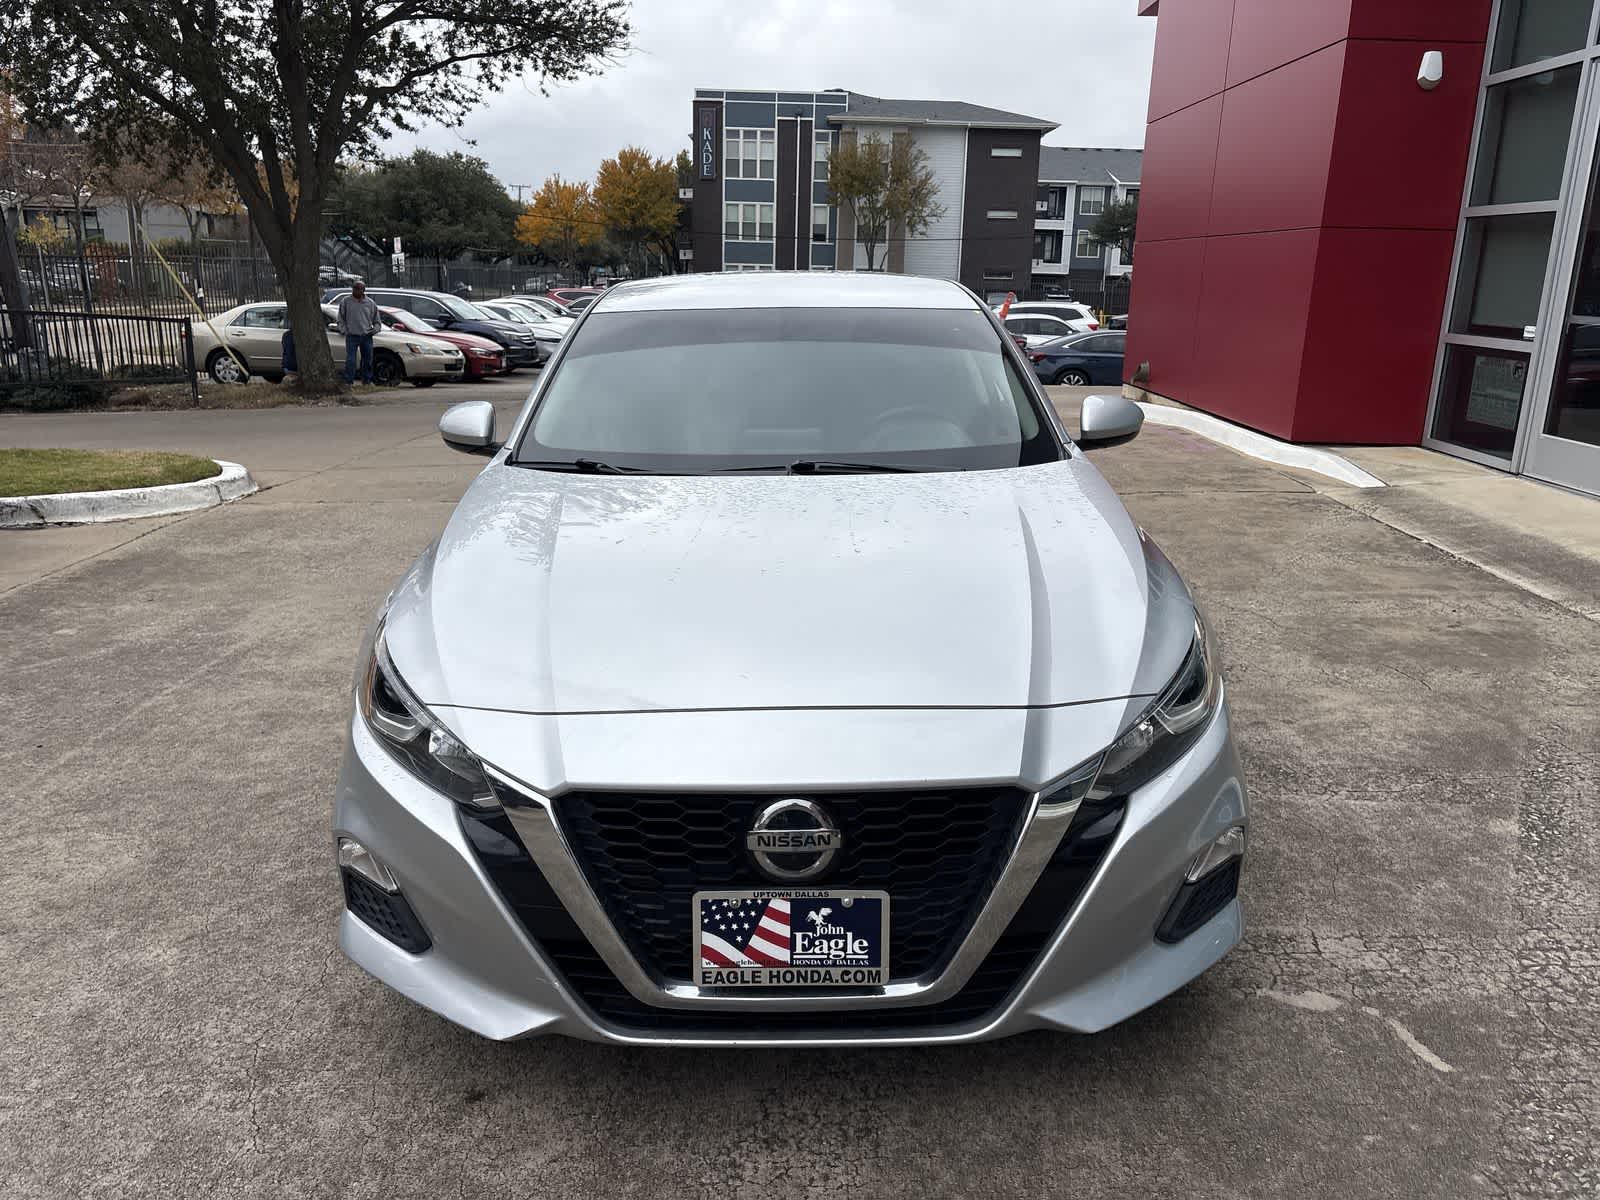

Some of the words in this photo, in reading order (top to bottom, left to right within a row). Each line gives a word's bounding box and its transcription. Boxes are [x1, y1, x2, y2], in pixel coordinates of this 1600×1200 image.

[703, 127, 712, 176] KADE
[757, 834, 831, 847] NISSAN
[793, 932, 869, 959] Eagle
[701, 970, 767, 985] EAGLE
[768, 970, 881, 985] HONDA.COM
